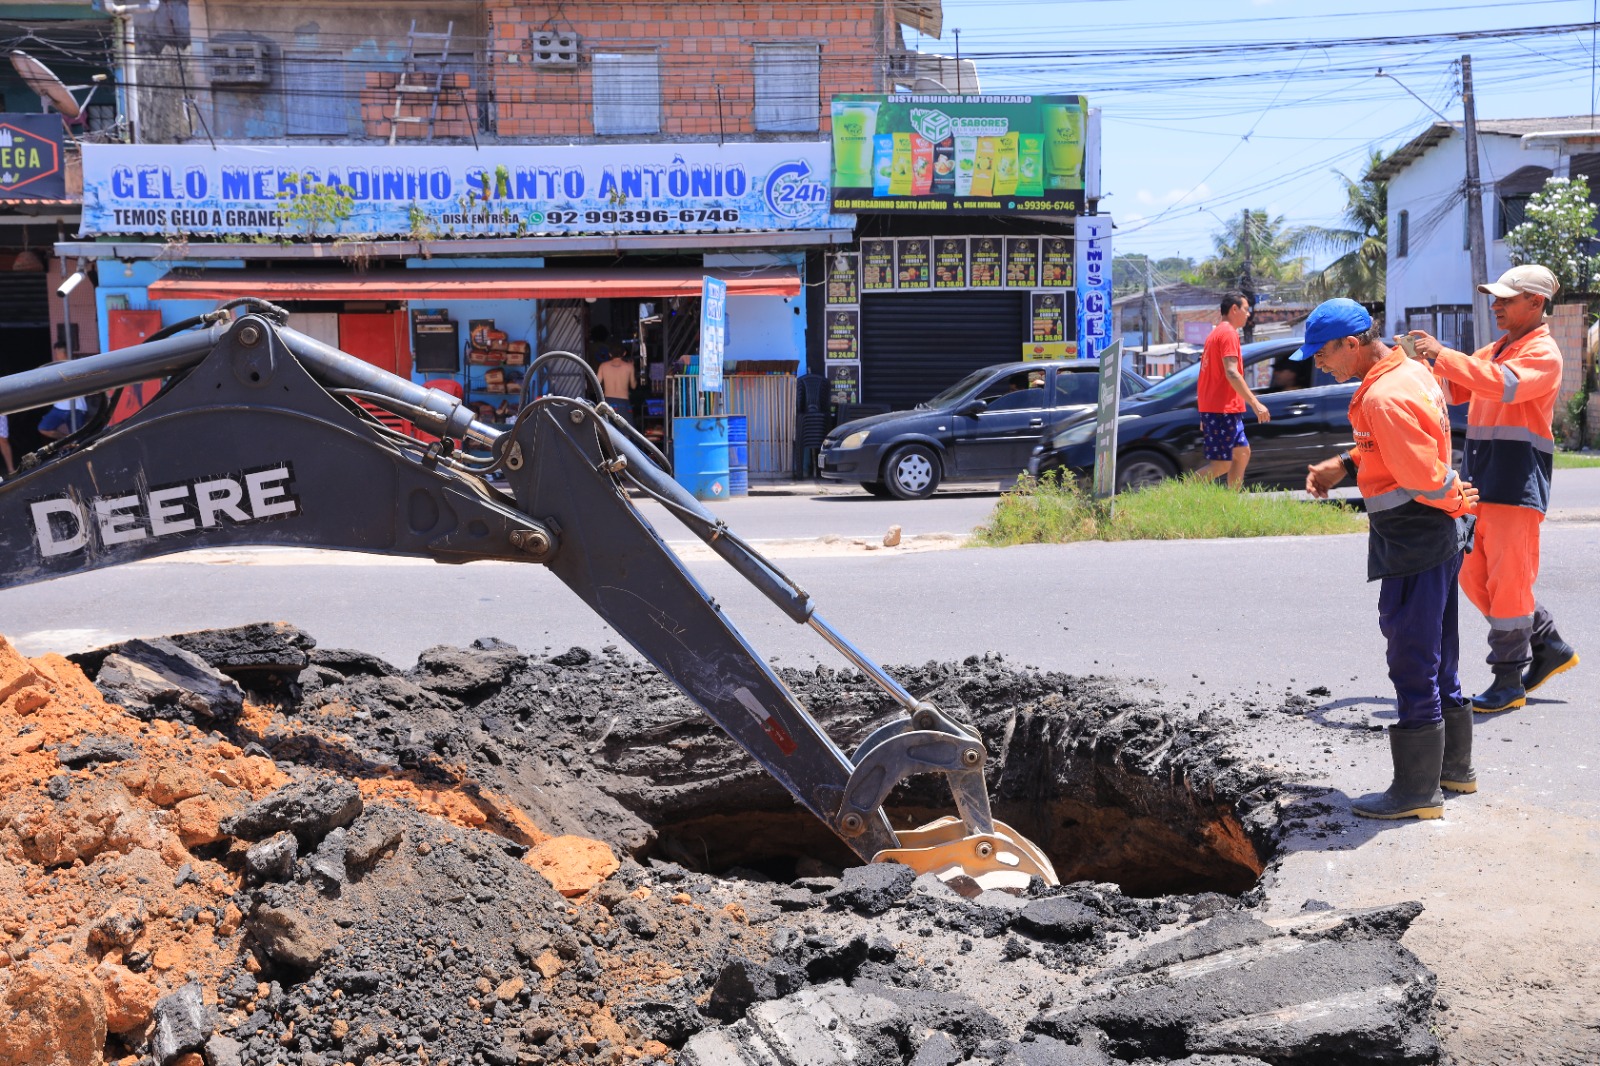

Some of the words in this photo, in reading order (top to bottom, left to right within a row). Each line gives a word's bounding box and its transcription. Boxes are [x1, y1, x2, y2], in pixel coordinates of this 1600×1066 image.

[887, 95, 963, 104] DISTRIBUIDOR
[966, 95, 1032, 104] AUTORIZADO
[952, 119, 959, 127] G
[960, 119, 1007, 127] SABORES
[111, 164, 208, 200] GELO
[221, 165, 452, 200] MERCADINHO
[465, 165, 585, 200] SANTO
[598, 153, 747, 199] ANTÔNIO
[779, 183, 827, 203] 24h
[834, 200, 850, 208] GELO
[851, 200, 894, 209] MERCADINHO
[896, 200, 917, 209] SANTO
[918, 200, 947, 210] ANTÔNIO
[113, 209, 166, 226] TEMOS
[171, 209, 208, 227] GELO
[212, 210, 223, 227] A
[443, 213, 468, 224] DISK
[472, 213, 519, 224] ENTREGA
[546, 211, 579, 225] 92
[585, 209, 739, 225] 99396-6746
[30, 466, 297, 557] DEERE
